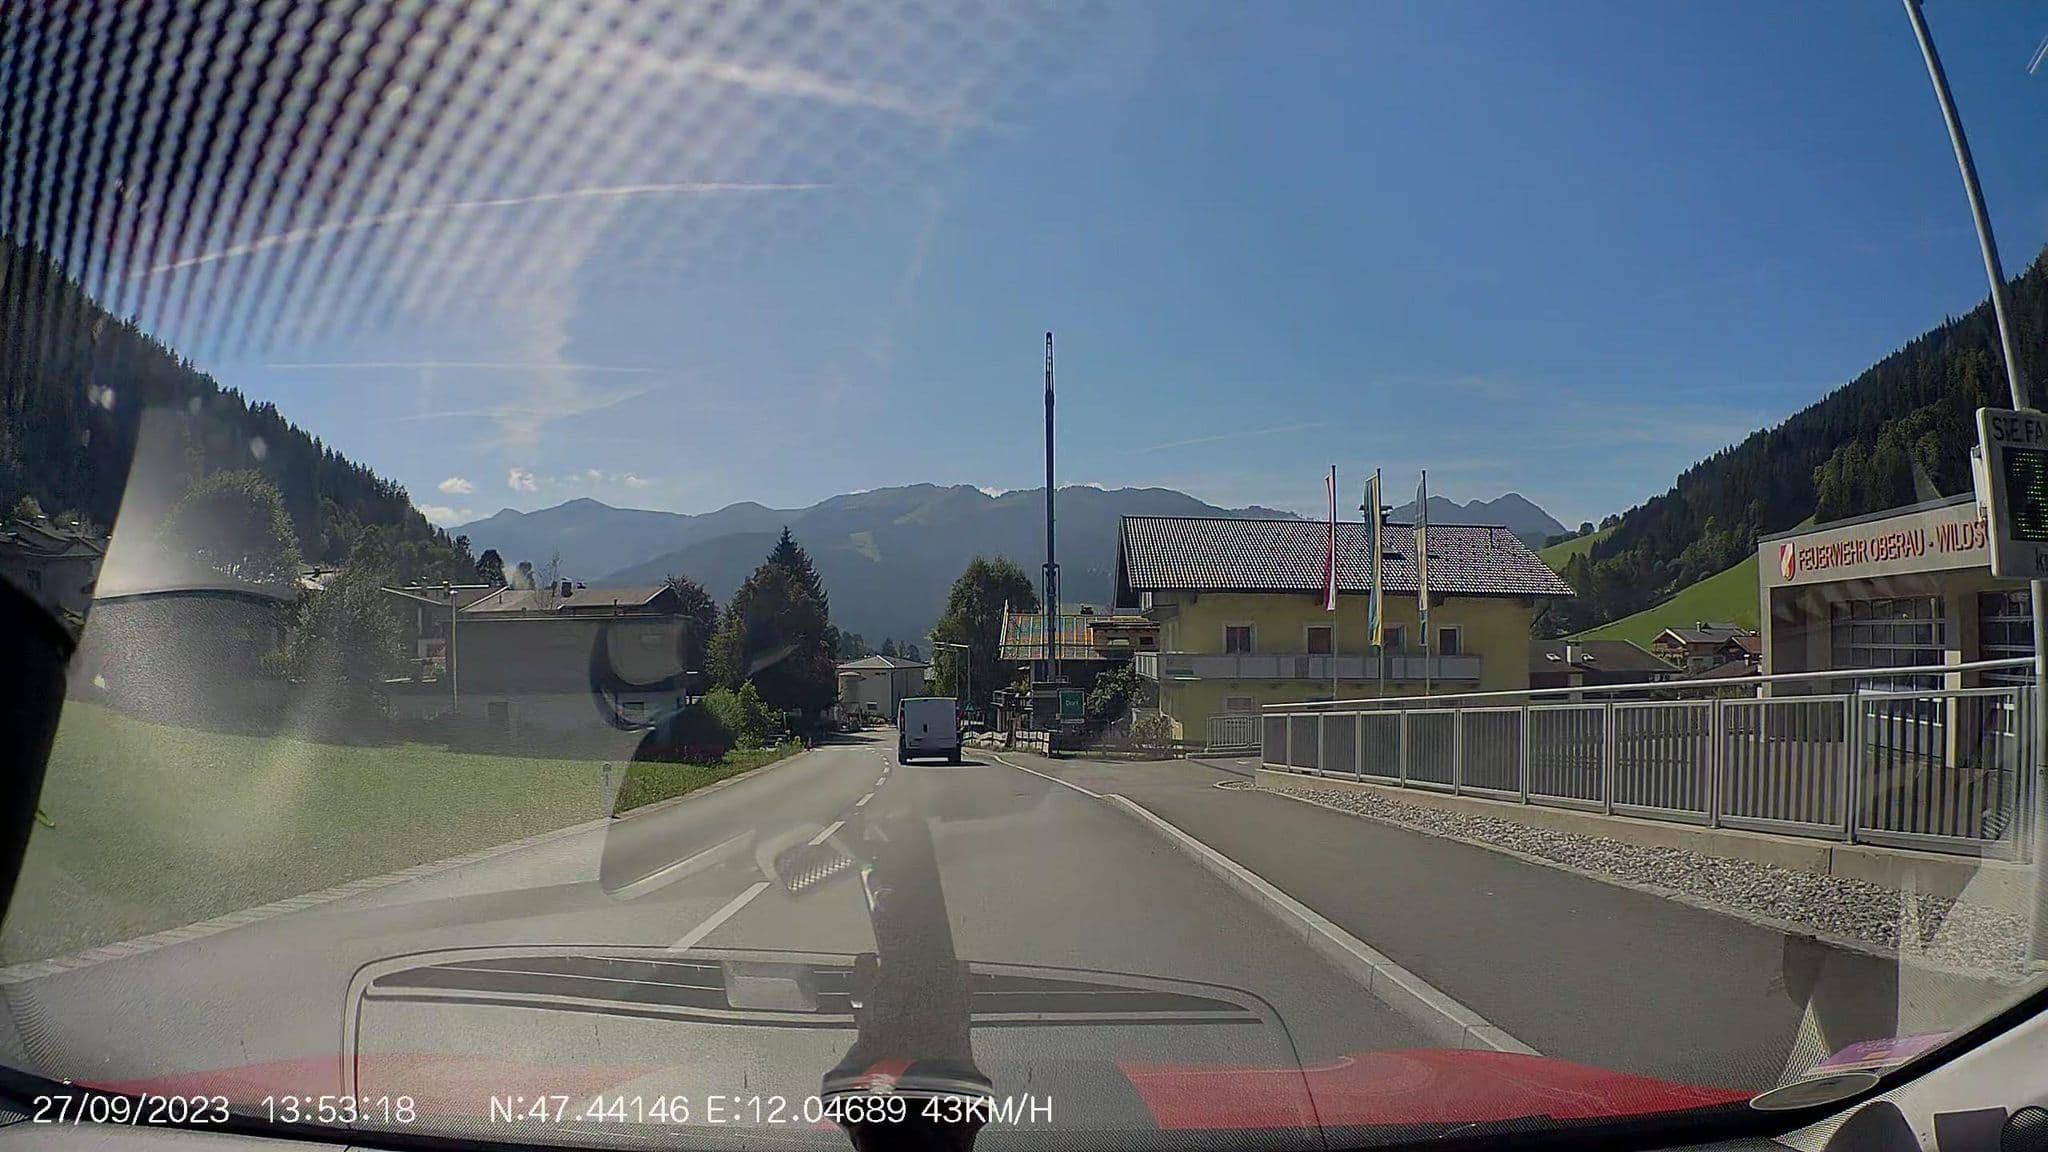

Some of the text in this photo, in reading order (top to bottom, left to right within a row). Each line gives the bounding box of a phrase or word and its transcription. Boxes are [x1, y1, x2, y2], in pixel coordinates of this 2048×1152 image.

[1992, 416, 2020, 442] SIE
[1798, 540, 1869, 571] FEUERWEHR
[1870, 528, 1925, 561] OBERAU
